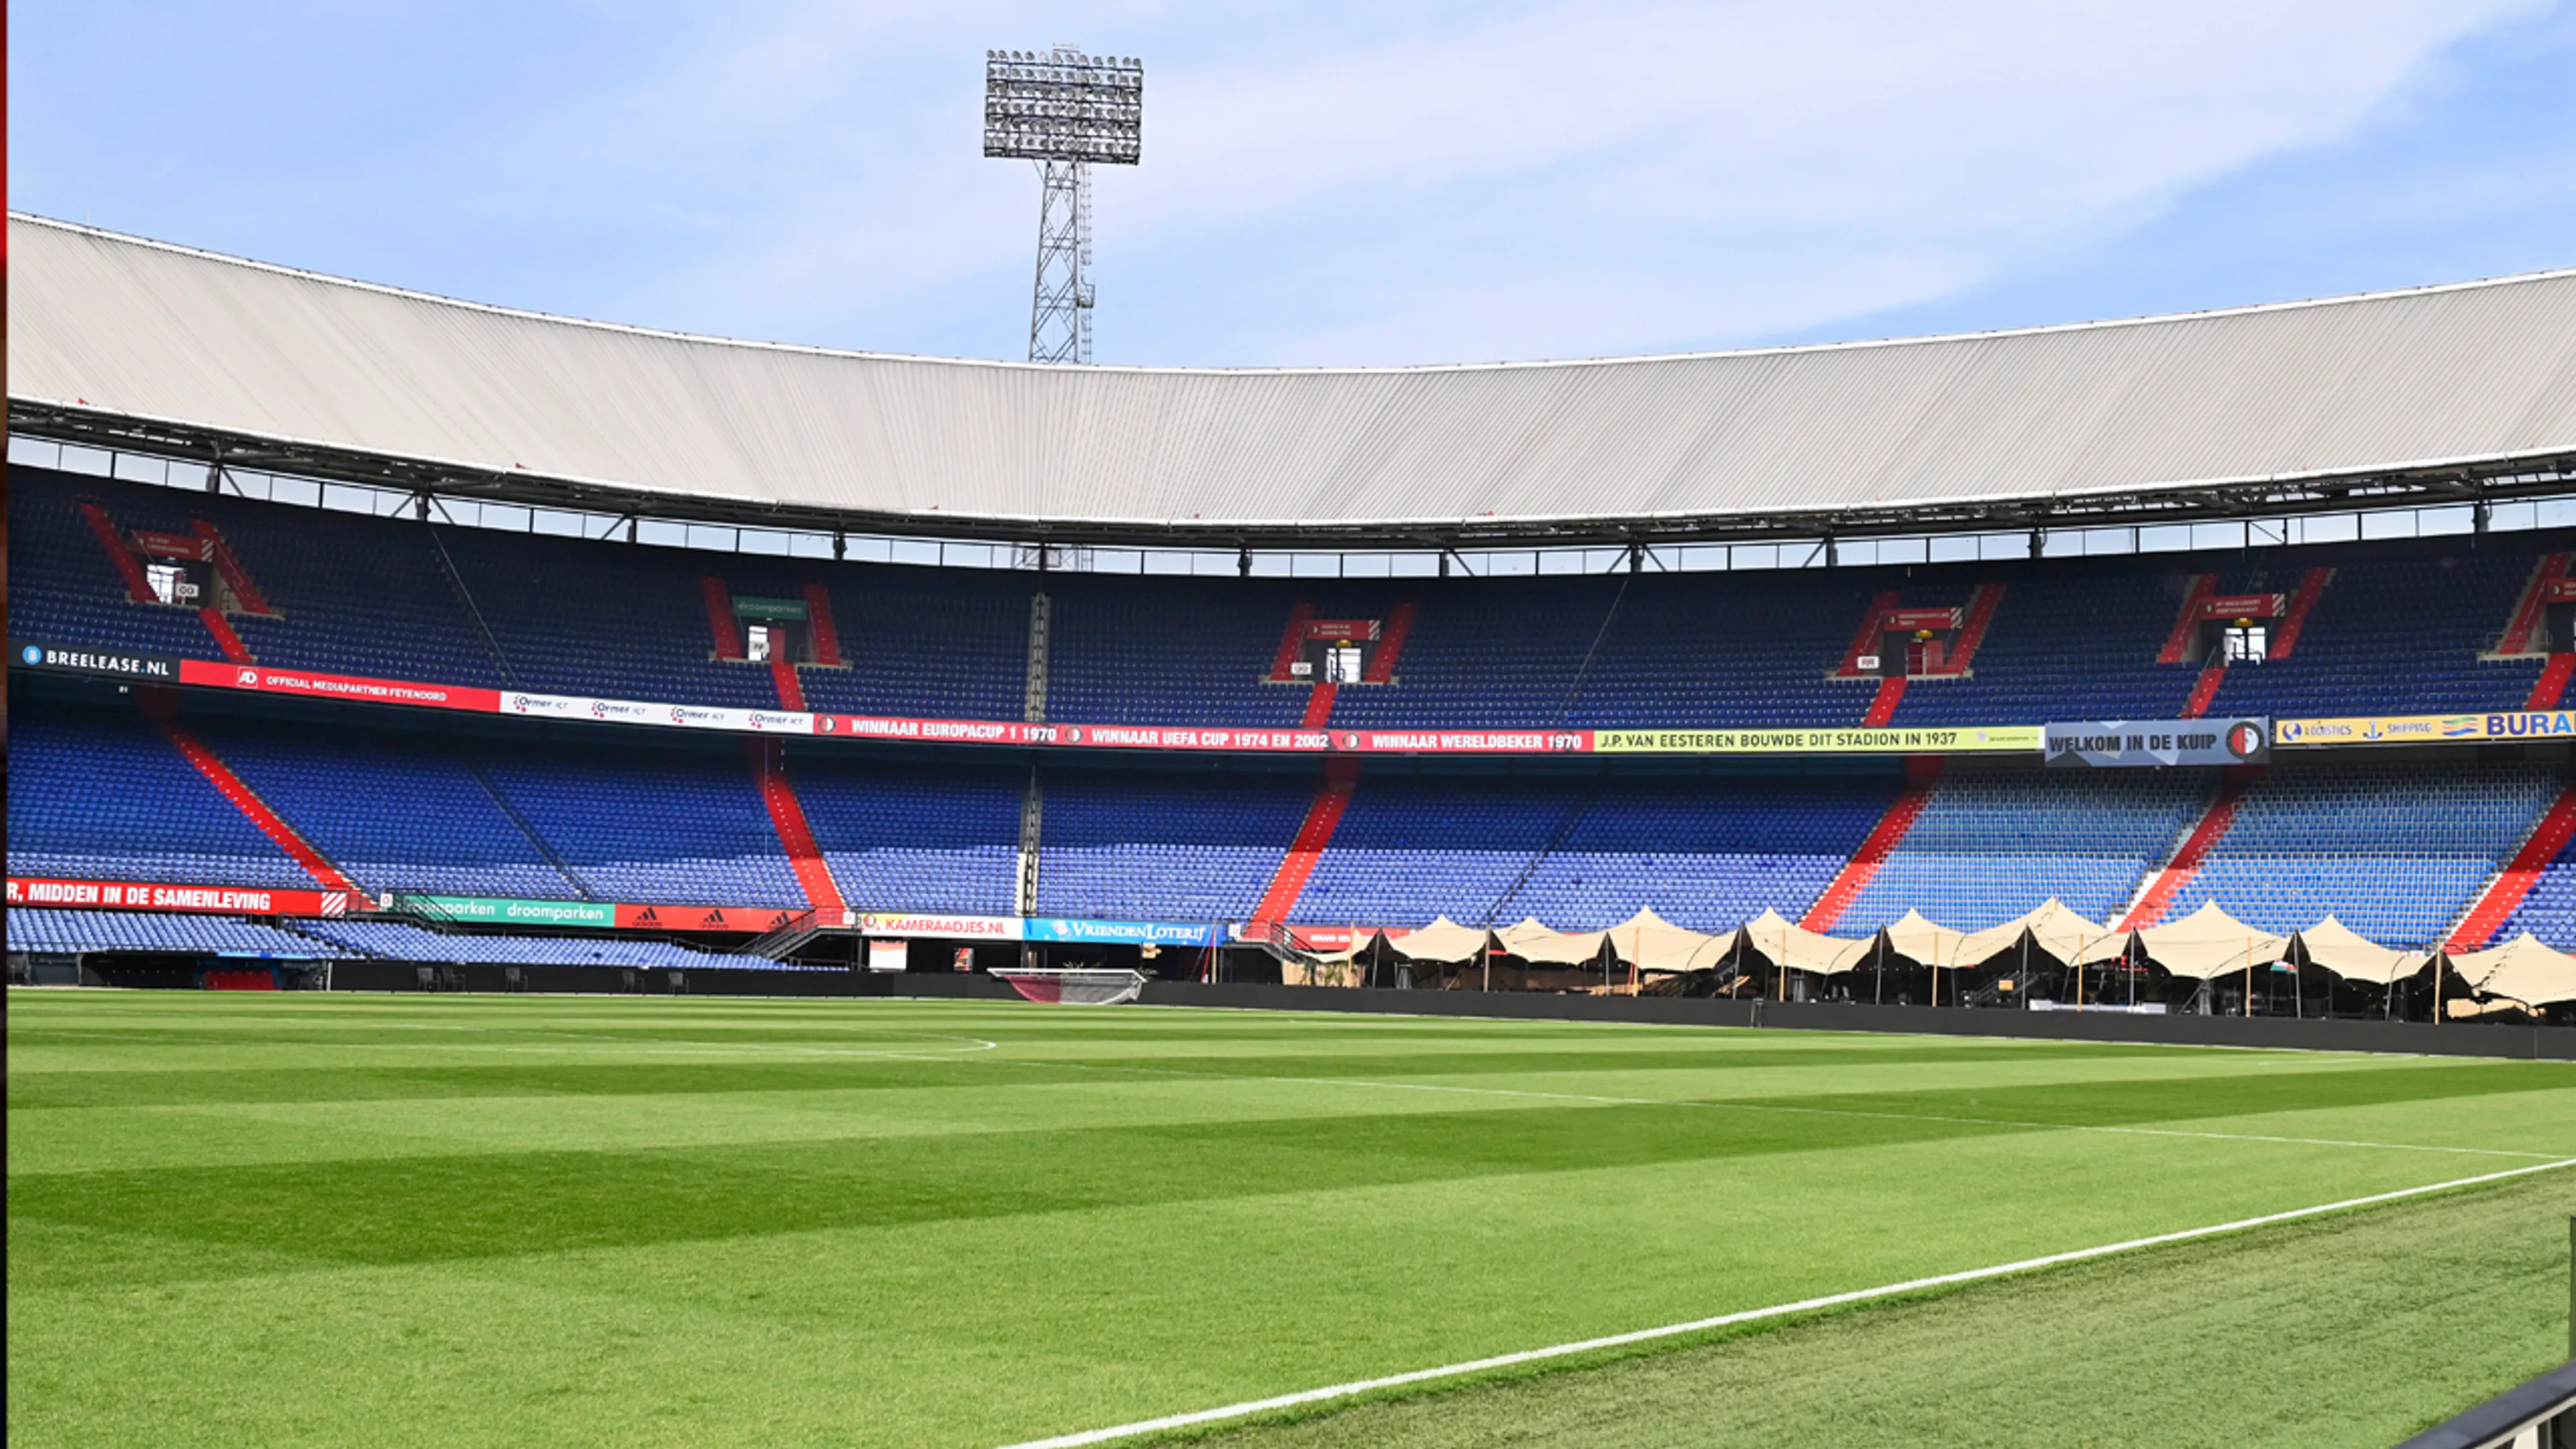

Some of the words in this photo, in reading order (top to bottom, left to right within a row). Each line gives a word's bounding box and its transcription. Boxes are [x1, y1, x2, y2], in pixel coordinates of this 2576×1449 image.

[46, 650, 169, 676] BREELEASE.NL
[239, 672, 257, 683] AD
[266, 676, 310, 689] OFFICIAL
[313, 681, 388, 696] MEDIAPARTNER
[389, 688, 447, 701] FEYENOORD
[852, 719, 918, 735] WINNAAR
[922, 722, 1004, 739] EUROPACUP
[1010, 726, 1016, 739] 1
[1022, 727, 1057, 741] 1970
[2305, 724, 2351, 737] LOGISTICS
[2387, 722, 2431, 734] SHIPPING
[2487, 712, 2576, 735] BURA
[1092, 729, 1157, 744] WINNAAR
[1163, 731, 1197, 745] UEFA
[1201, 732, 1228, 746] CUP
[1234, 733, 1268, 747] 1974
[1272, 734, 1291, 747] EN
[1294, 734, 1328, 747] 2002
[1372, 734, 1438, 748] WINNAAR
[1440, 734, 1543, 749] WERELDBEKER
[1547, 734, 1581, 749] 1970
[1601, 735, 1623, 747] J.P.
[1626, 735, 1654, 747] VAN
[1660, 734, 1734, 747] EESTEREN
[1741, 734, 1804, 747] BOUWDE
[1811, 733, 1831, 746] DIT
[1837, 733, 1900, 745] STADION
[1906, 733, 1921, 745] IN
[1926, 732, 1957, 745] 1937
[2049, 736, 2120, 752] WELKOM
[2127, 735, 2144, 751] IN
[2150, 735, 2171, 750] DE
[2178, 734, 2216, 749] KUIP
[28, 883, 97, 903] MIDDEN
[103, 886, 120, 904] IN
[126, 887, 148, 904] DE
[153, 888, 270, 910] SAMENLEVING
[507, 903, 604, 921] droomparken
[885, 919, 1006, 934] KAMERAADJES.NL
